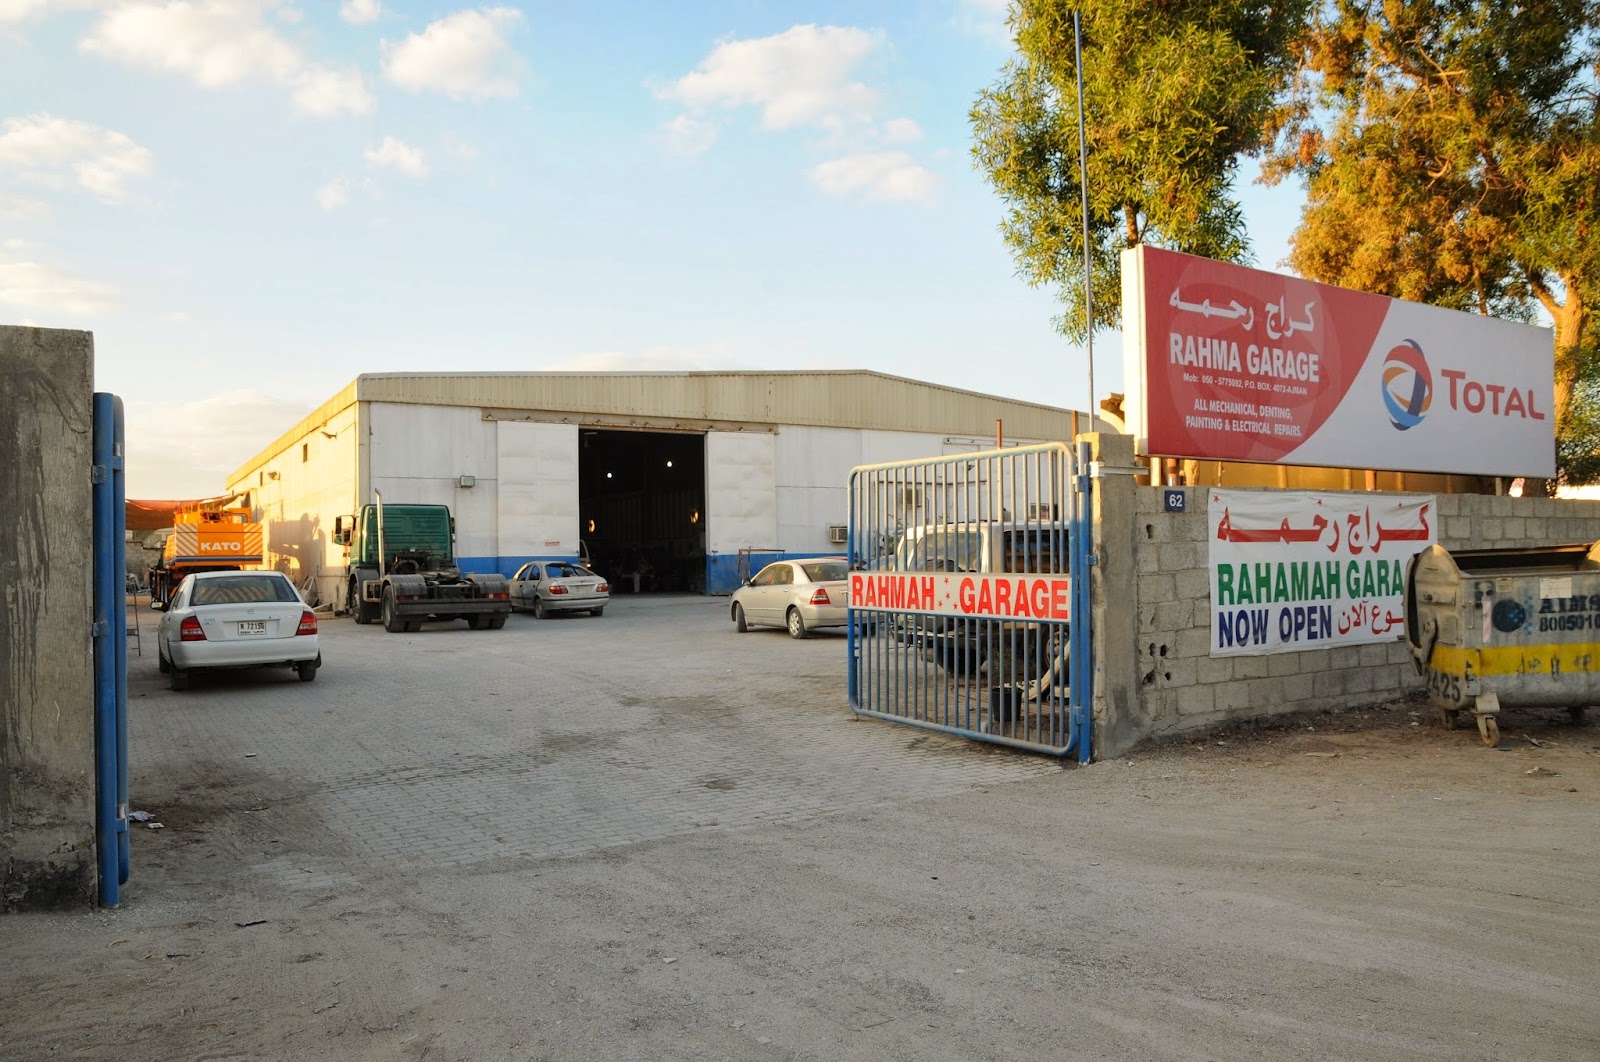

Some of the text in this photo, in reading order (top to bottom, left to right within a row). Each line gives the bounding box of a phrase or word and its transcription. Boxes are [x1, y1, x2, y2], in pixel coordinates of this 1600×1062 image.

[1265, 295, 1315, 339] كراج
[1170, 332, 1319, 382] RAHMA GARAGE
[1183, 372, 1199, 383] Mob:
[1245, 380, 1256, 389] P.O.
[1257, 381, 1272, 391] BOX:
[1441, 368, 1545, 420] TOTAL
[1185, 415, 1303, 436] PAINTING & ELECTRICAL REPAIRS.
[1194, 398, 1293, 420] ALL MECHANICAL, DENTING,
[1169, 494, 1183, 507] 62
[201, 542, 241, 551] KATO
[1347, 504, 1429, 555] كراج
[852, 575, 1068, 619] RAHMAH GARAGE
[1218, 560, 1404, 606] RAHAMAH GARA
[1218, 605, 1332, 648] NOW OPEN
